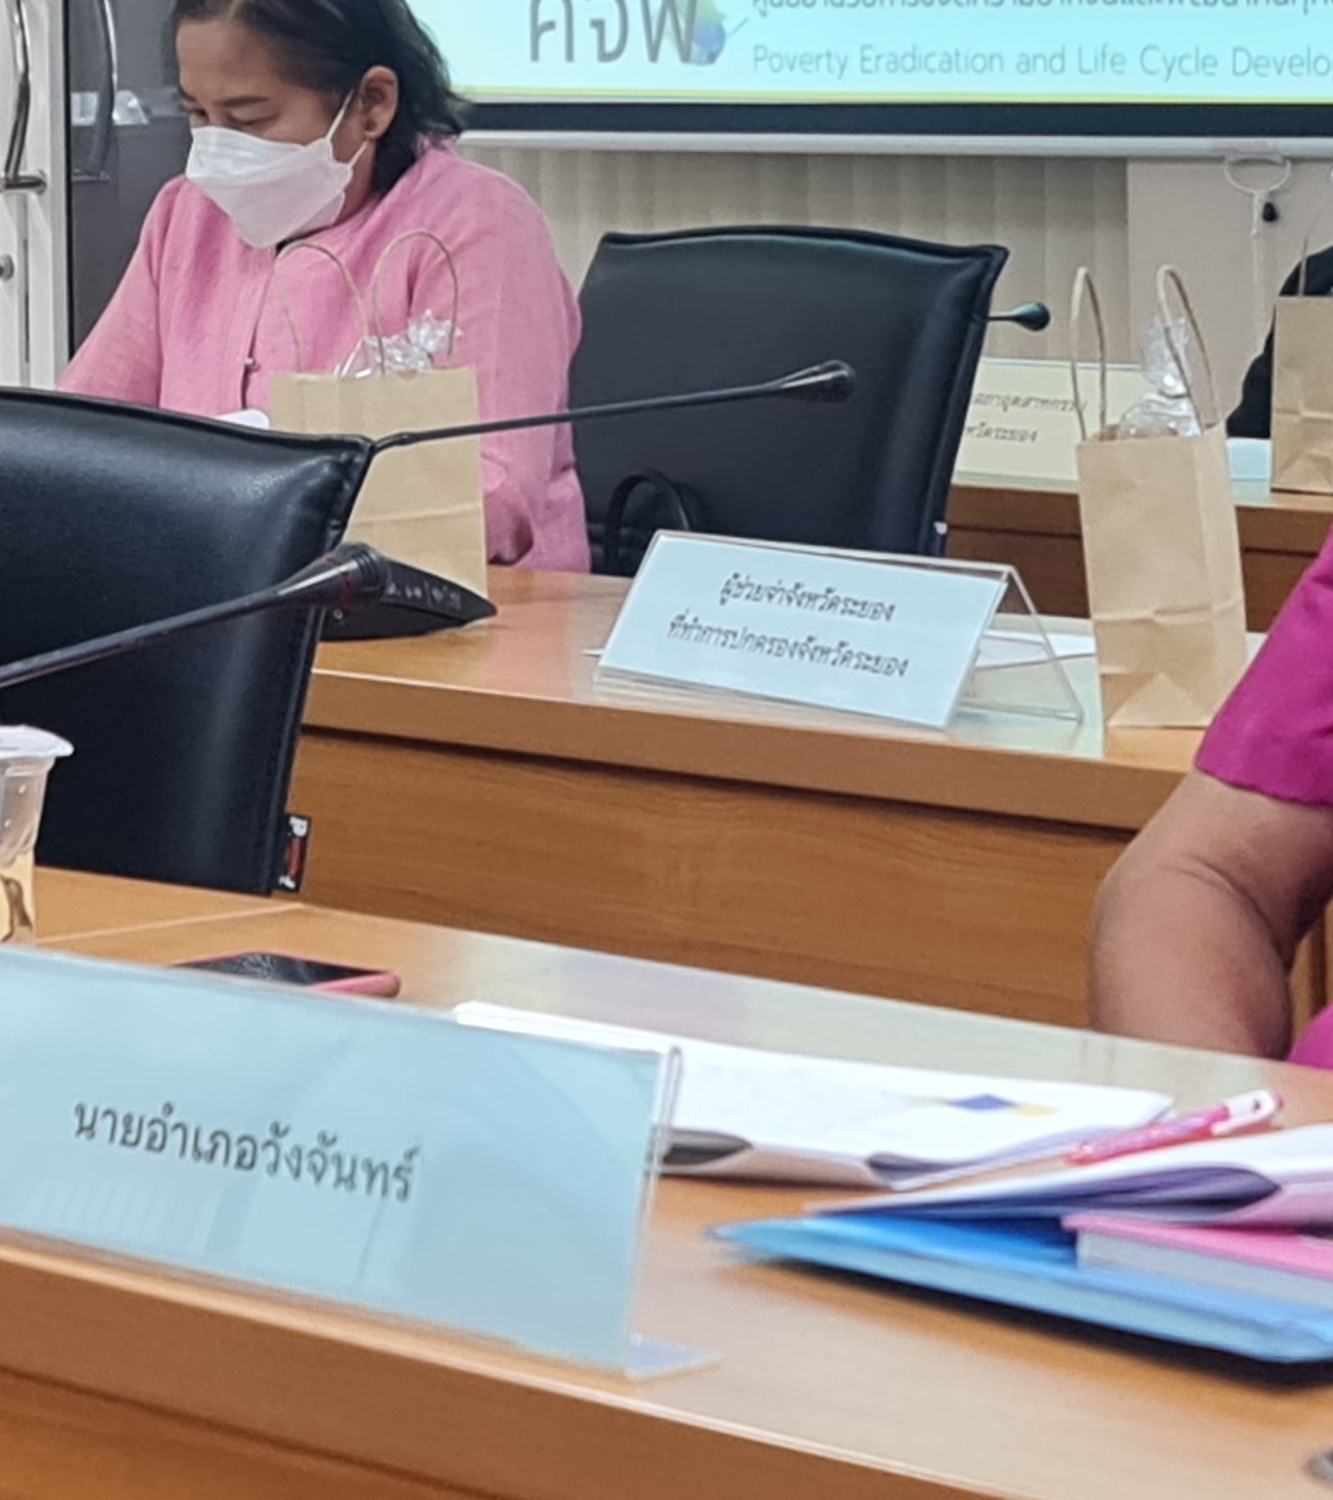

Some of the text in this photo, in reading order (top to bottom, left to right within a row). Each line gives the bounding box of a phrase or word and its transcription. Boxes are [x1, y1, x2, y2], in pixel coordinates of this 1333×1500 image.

[753, 42, 1333, 83] Poverty Eradication and Life Cycle Develo
[73, 1101, 420, 1204] นายอำเภอวังจันทร์
